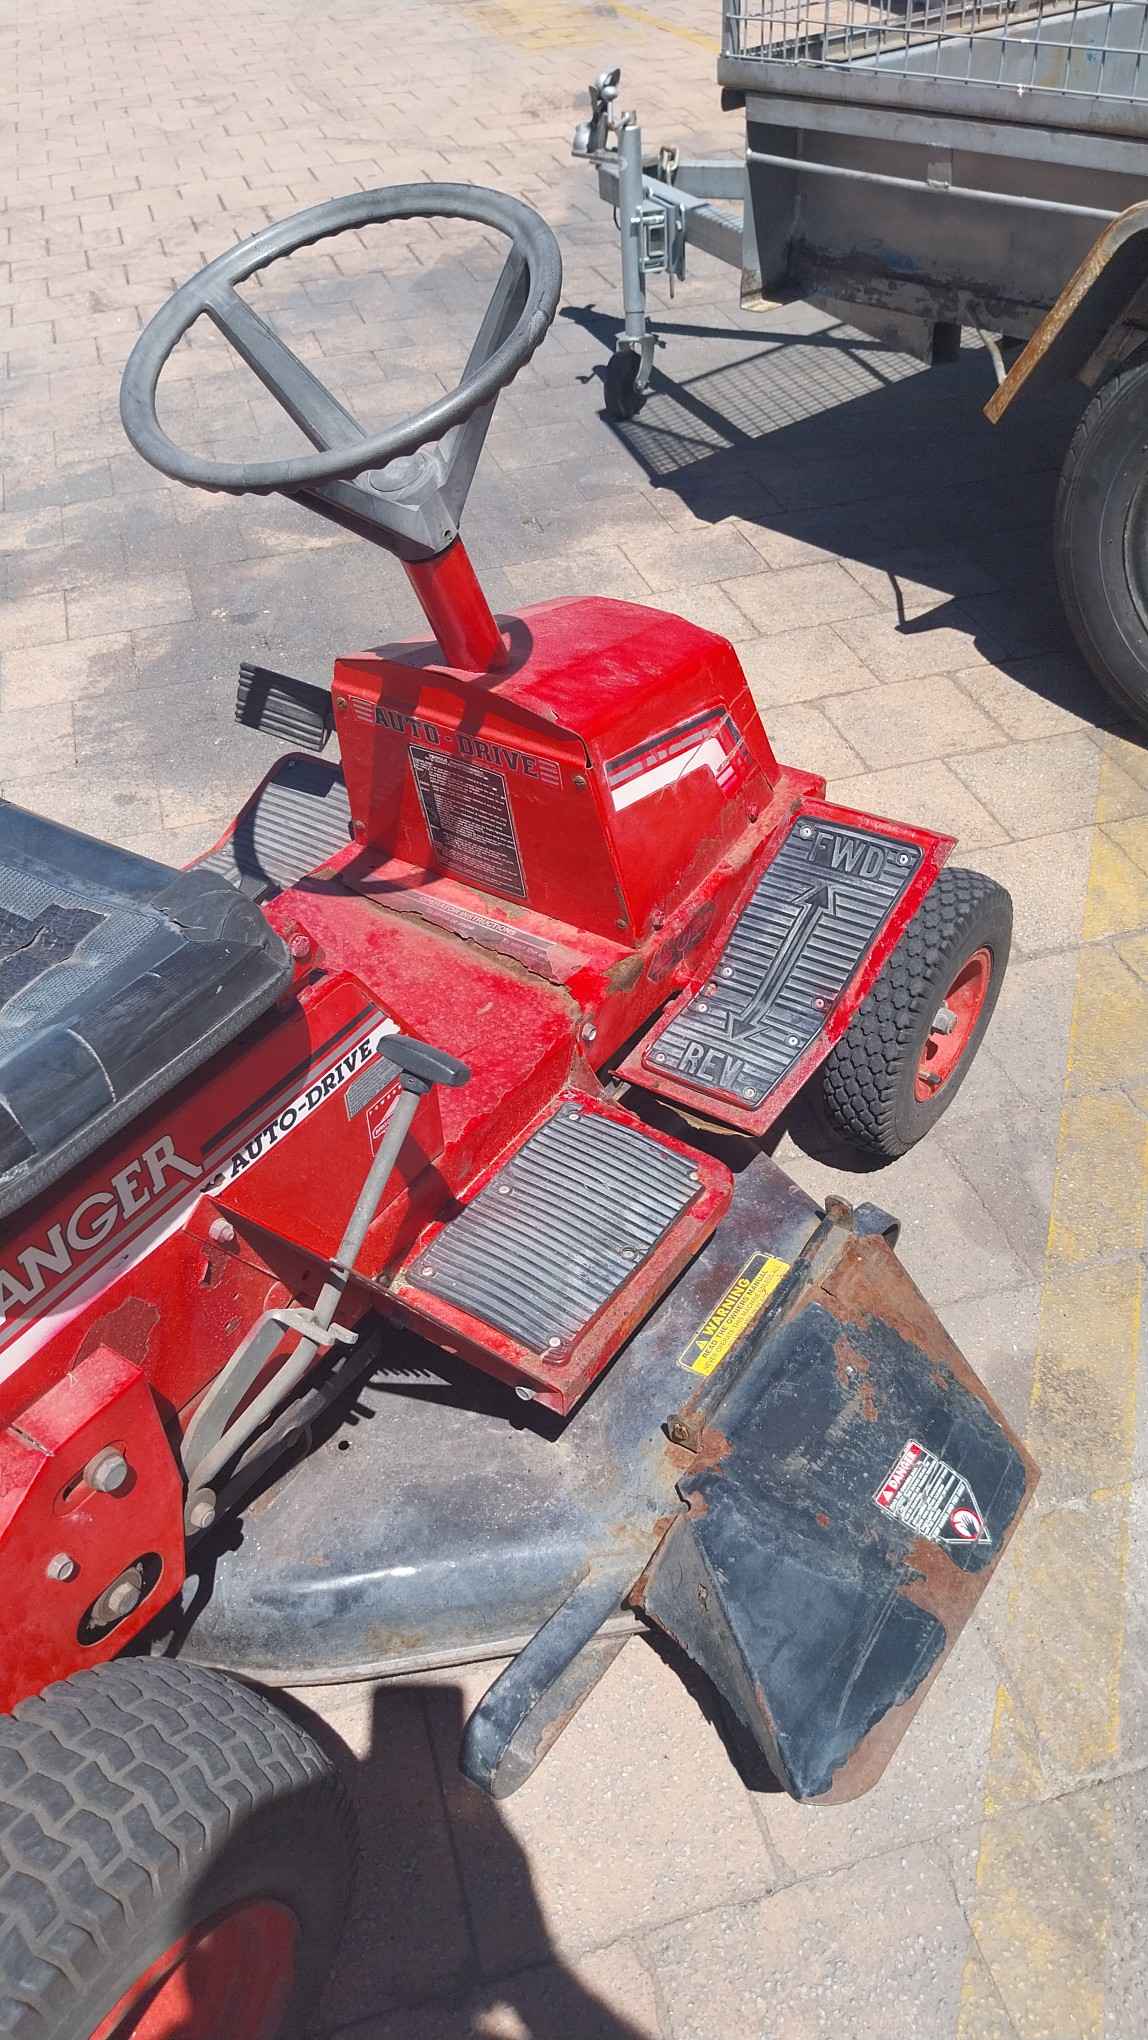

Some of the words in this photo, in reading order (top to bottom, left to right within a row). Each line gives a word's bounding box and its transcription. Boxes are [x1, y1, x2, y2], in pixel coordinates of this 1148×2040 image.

[375, 704, 440, 745] AUTO
[456, 732, 540, 780] DRIVE
[808, 831, 887, 879] FWD
[677, 1041, 745, 1088] REV
[228, 1038, 374, 1178] AUTO-DRIVE
[702, 1277, 751, 1336] WARNING
[702, 1340, 718, 1358] READ
[716, 1325, 728, 1338] THE
[746, 1269, 768, 1295] MANUAL
[891, 1451, 919, 1488] DANGER
